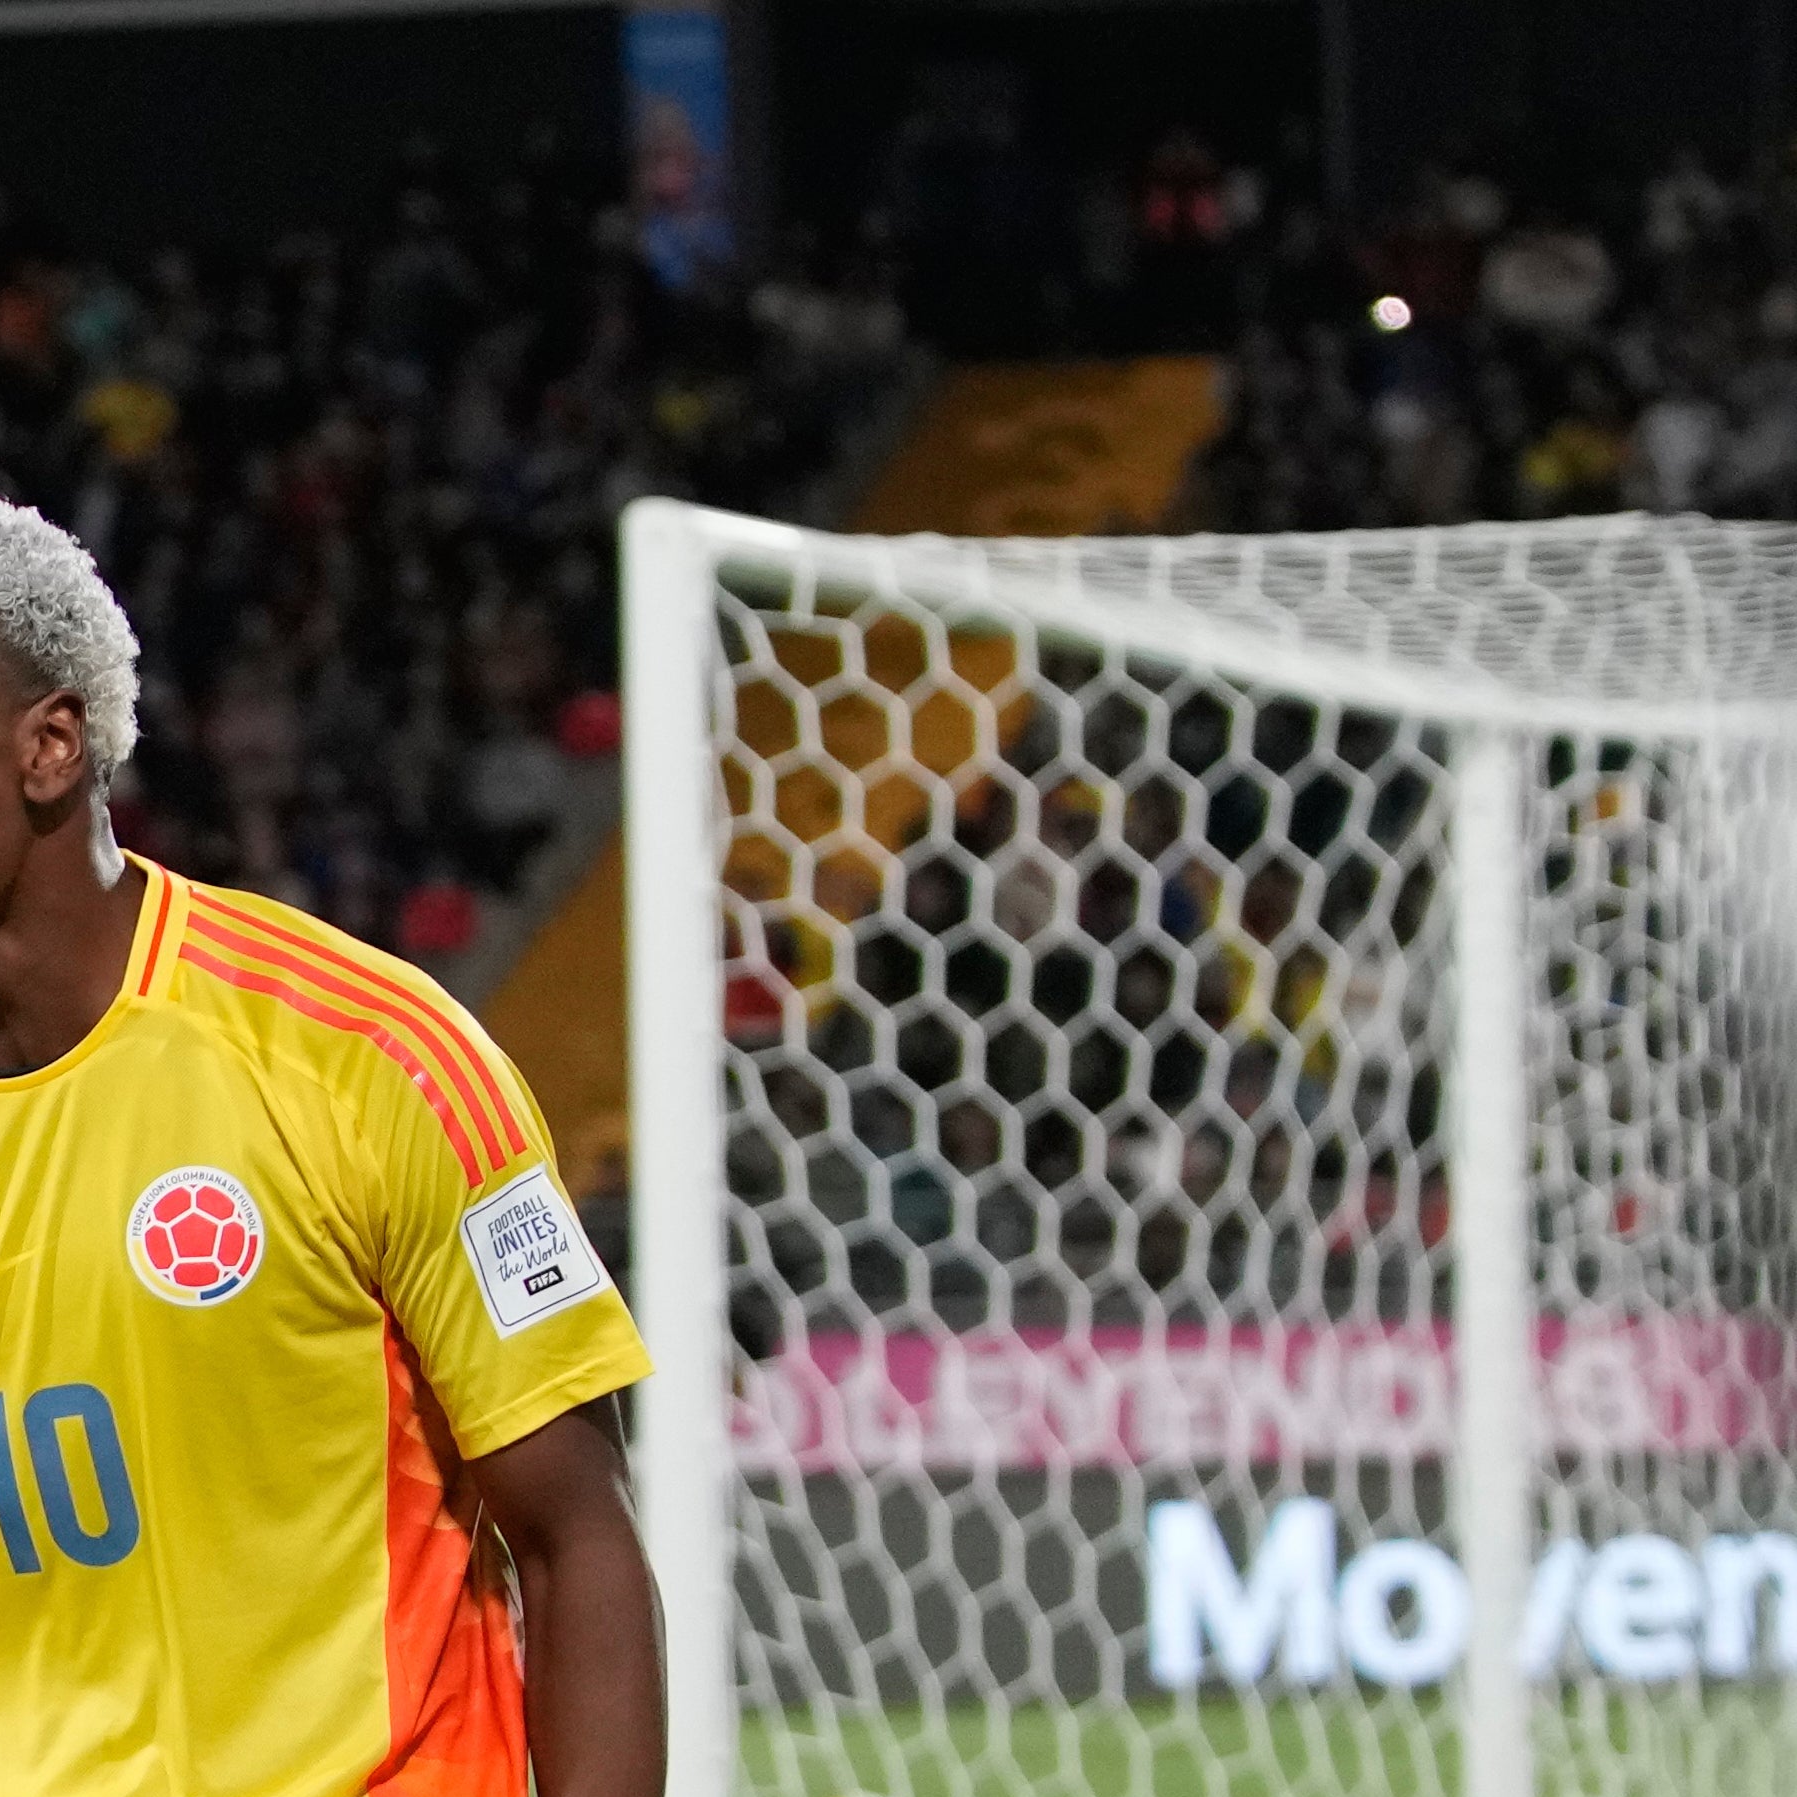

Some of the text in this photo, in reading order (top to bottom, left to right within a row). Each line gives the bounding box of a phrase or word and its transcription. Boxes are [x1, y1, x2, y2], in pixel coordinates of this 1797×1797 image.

[488, 1194, 548, 1239] FOOTBALL
[493, 1211, 558, 1260] UNITES
[497, 1232, 570, 1282] the World
[527, 1270, 560, 1292] FIFA
